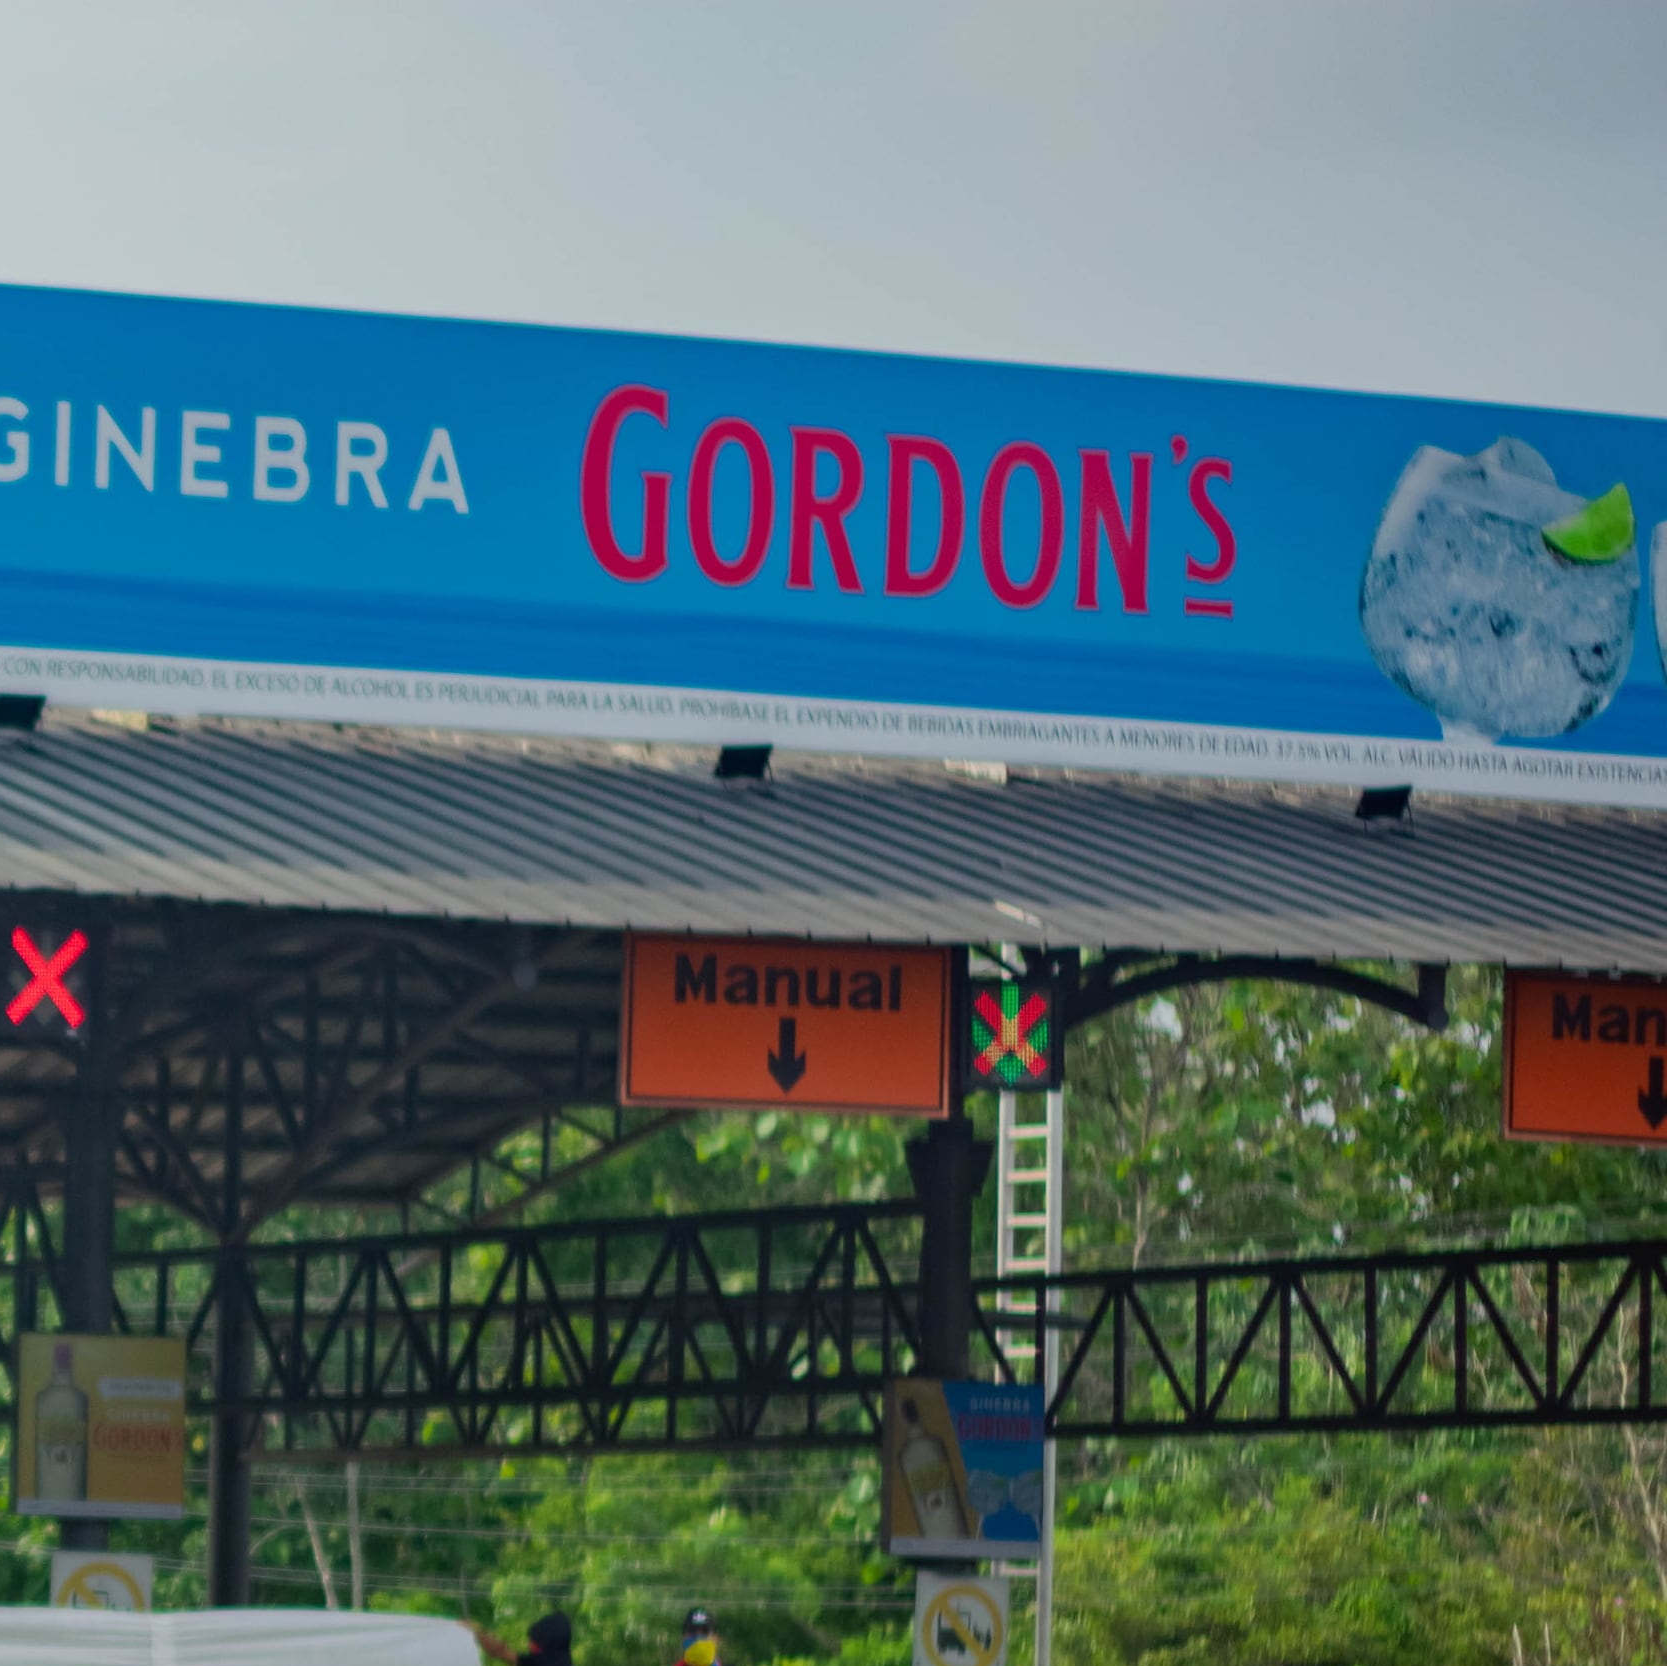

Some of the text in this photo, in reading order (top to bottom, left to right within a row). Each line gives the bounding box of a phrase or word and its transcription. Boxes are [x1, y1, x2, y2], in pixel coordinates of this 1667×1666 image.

[579, 382, 1238, 619] GORDON'S
[4, 655, 42, 677] CON
[235, 671, 300, 694] EXCESO
[304, 675, 327, 696] DE
[331, 676, 410, 701] ALCOHOL
[415, 681, 434, 703] ES
[438, 682, 540, 710] PERJUDICIAL
[547, 689, 588, 713] PARA
[593, 692, 614, 715] LA
[883, 711, 902, 734] DE
[907, 712, 974, 739] BEBIDAS
[1120, 726, 1195, 753] MENORES
[1199, 732, 1219, 755] DE
[1460, 750, 1508, 775] HASTA
[673, 954, 901, 1014] Manual
